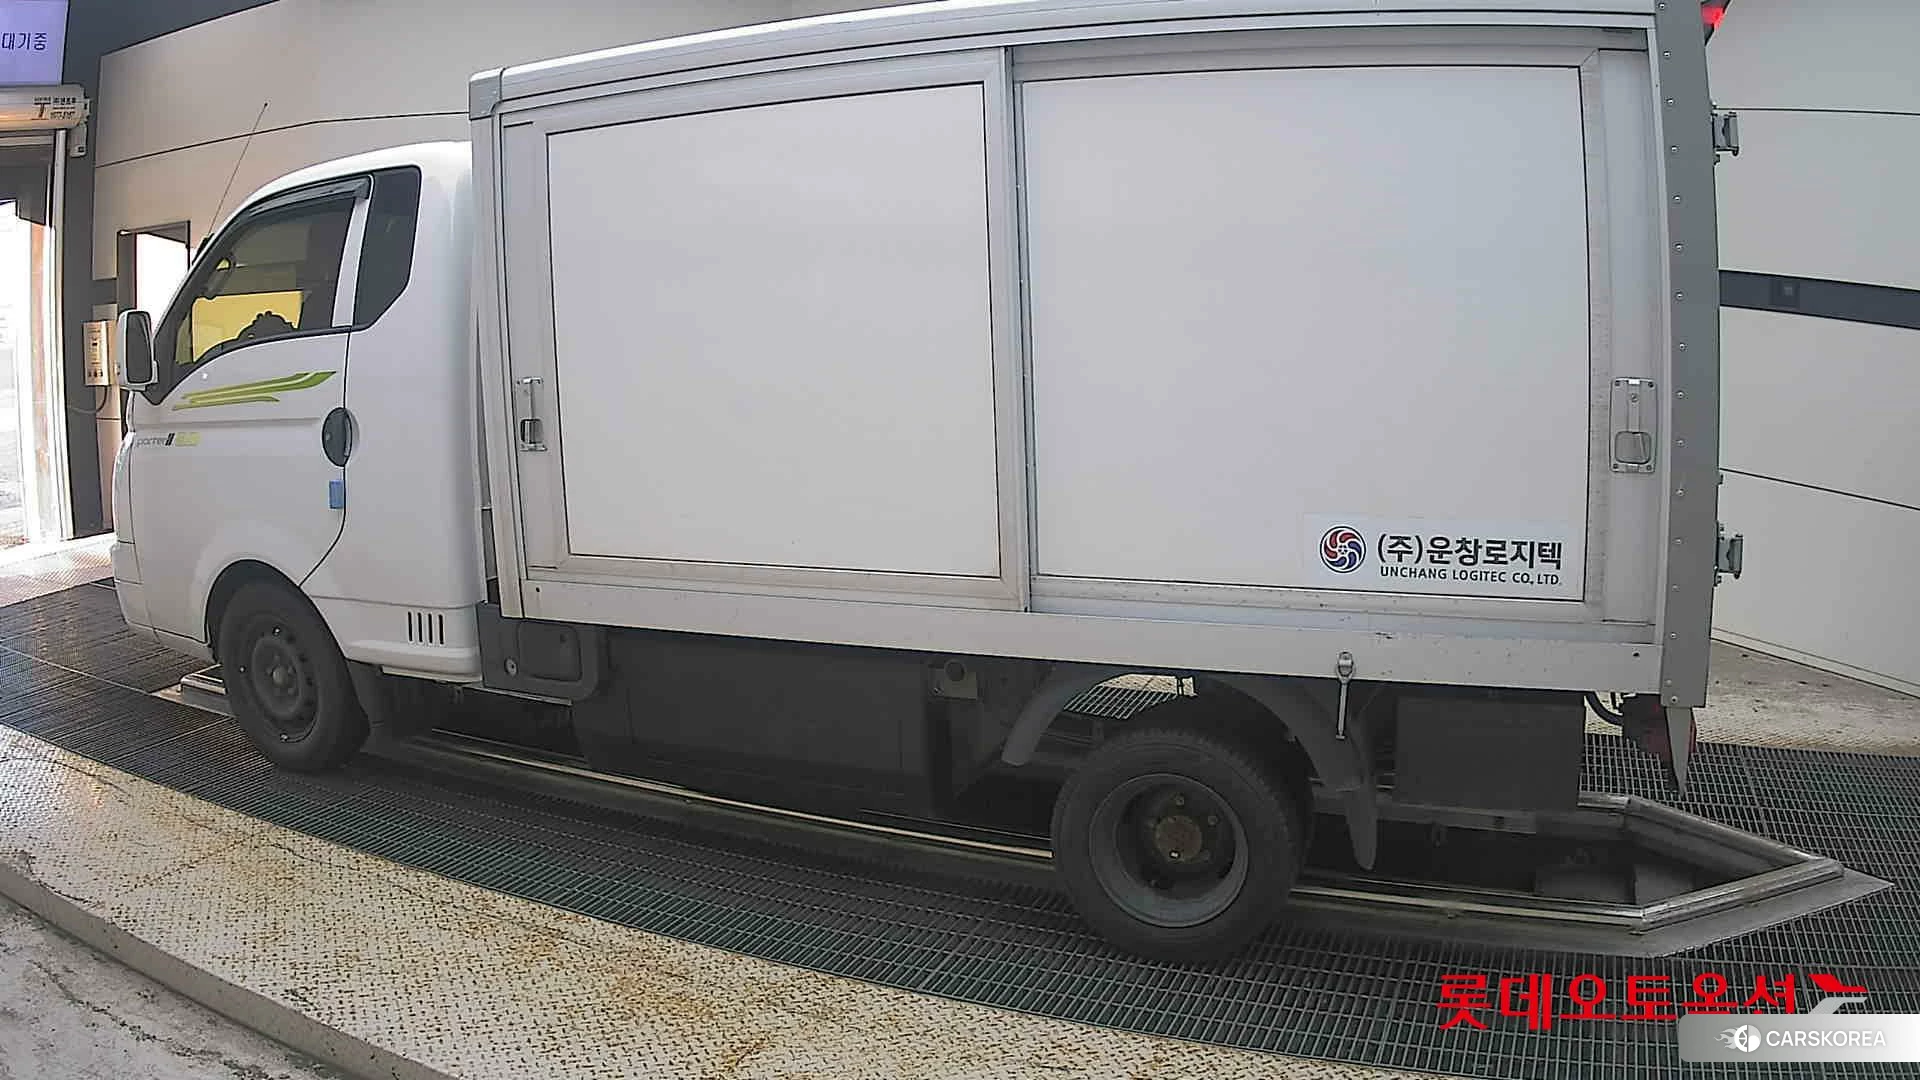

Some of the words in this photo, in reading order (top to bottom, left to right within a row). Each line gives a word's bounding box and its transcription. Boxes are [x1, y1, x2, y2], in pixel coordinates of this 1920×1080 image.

[2, 32, 47, 50] 대기중
[1377, 533, 1562, 570] (주)운창로지텍
[1380, 566, 1447, 580] UNCHANG
[1452, 569, 1507, 583] LOGITEC
